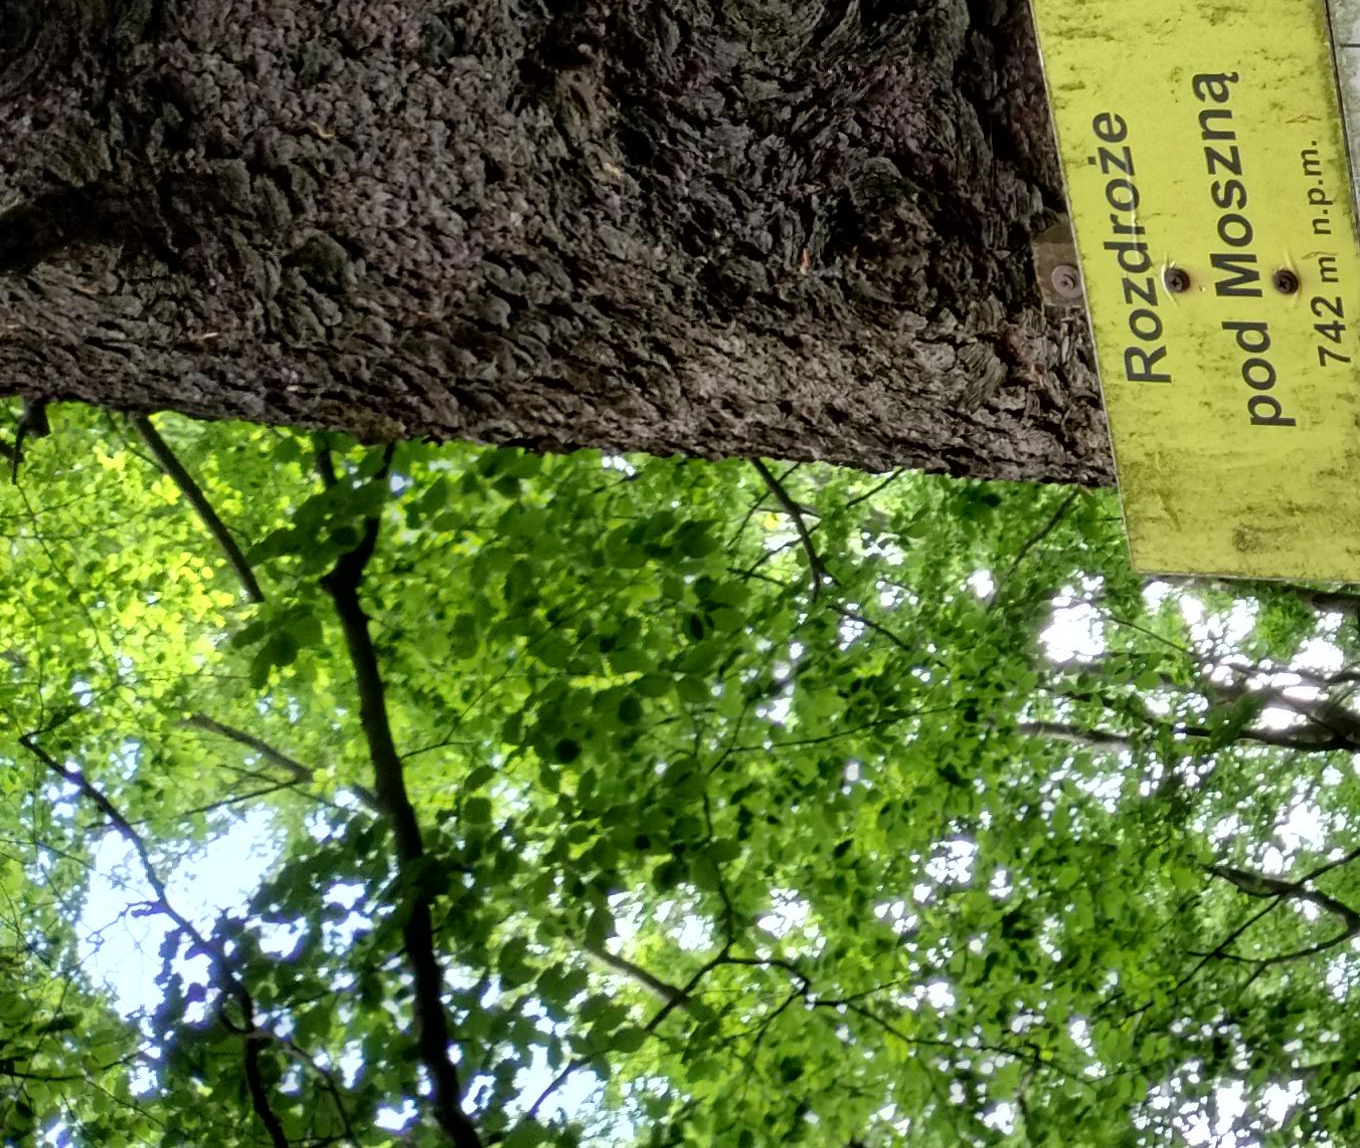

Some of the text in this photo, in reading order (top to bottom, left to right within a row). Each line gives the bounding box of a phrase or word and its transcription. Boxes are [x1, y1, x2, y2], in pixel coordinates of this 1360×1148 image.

[1087, 112, 1172, 383] Rozdroże
[1191, 72, 1295, 426] pod Moszną
[1299, 140, 1350, 367] 742 m n.p.m.
